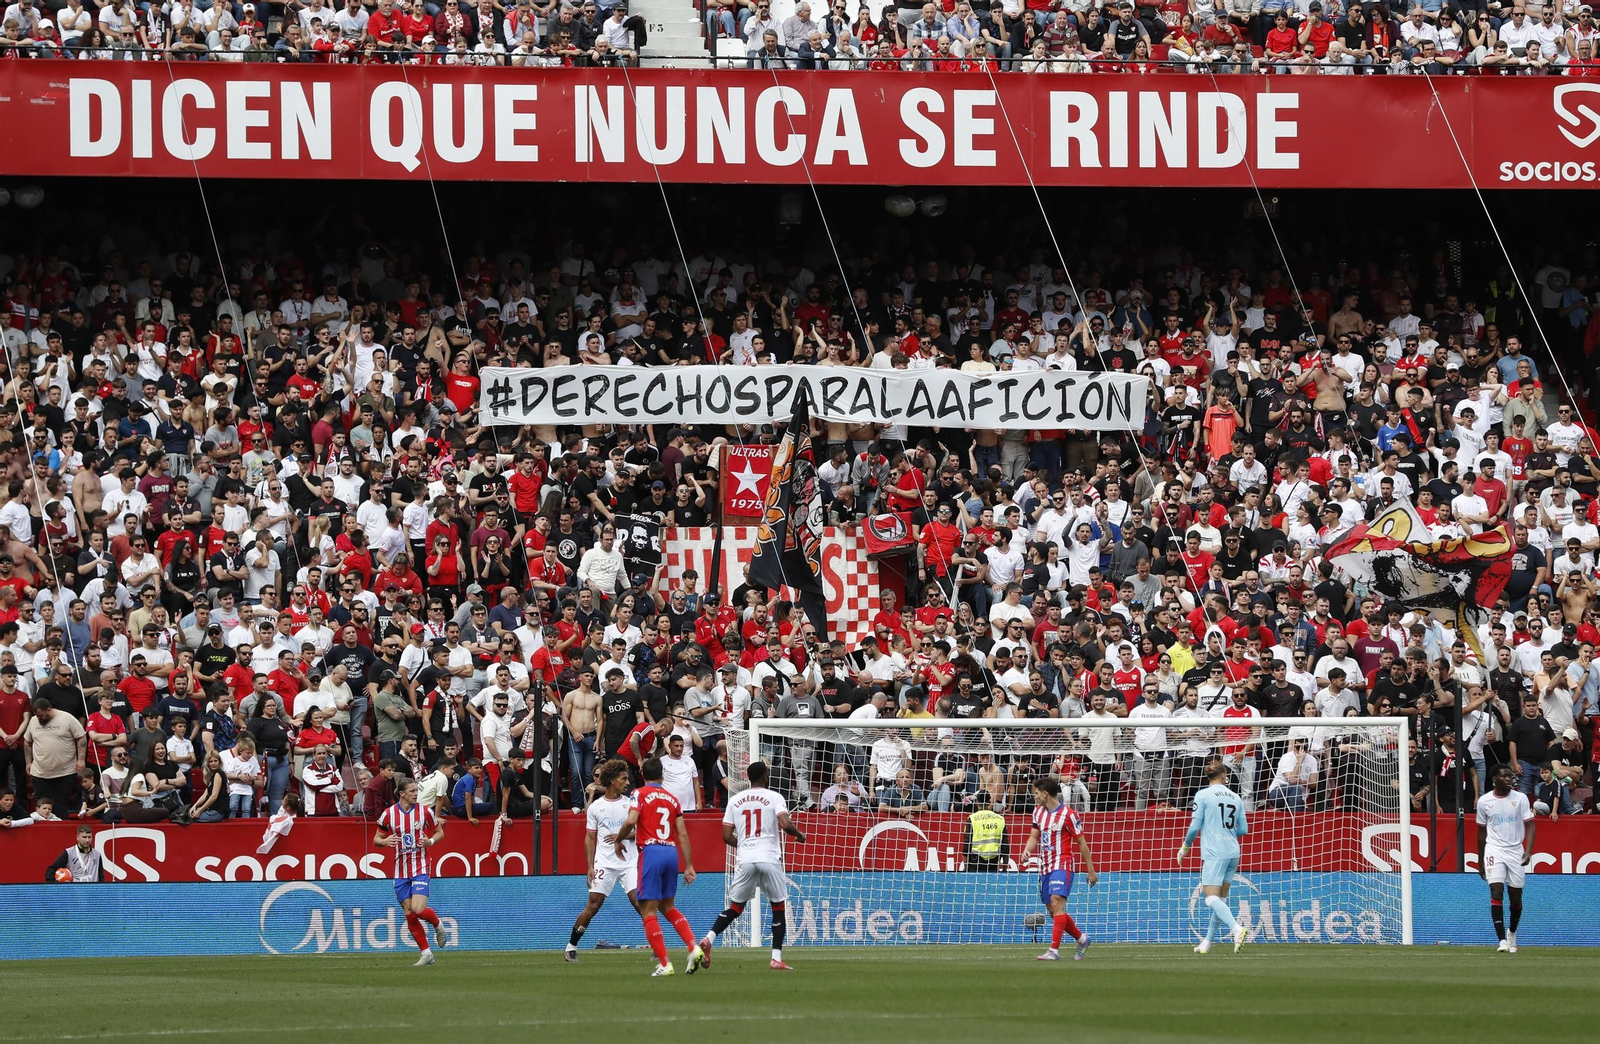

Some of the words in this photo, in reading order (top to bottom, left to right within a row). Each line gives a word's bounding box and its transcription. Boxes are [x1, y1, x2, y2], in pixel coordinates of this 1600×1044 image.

[69, 78, 332, 161] DICEN
[370, 81, 538, 173] QUE
[575, 85, 868, 166] NUNCA
[899, 87, 997, 168] SE
[1050, 91, 1300, 169] RINDE
[487, 371, 1132, 423] #DERECHOSPARALAAFICIÓN
[732, 446, 769, 458] ULTRAS
[731, 499, 763, 510] 1975
[608, 701, 631, 713] BOSS
[734, 795, 770, 808] LUKÉBAKIO
[1218, 802, 1236, 829] 13
[656, 806, 670, 840] 3
[742, 808, 762, 839] 11
[1486, 856, 1494, 866] 18
[784, 899, 924, 946] Midea
[1224, 899, 1382, 944] Midea
